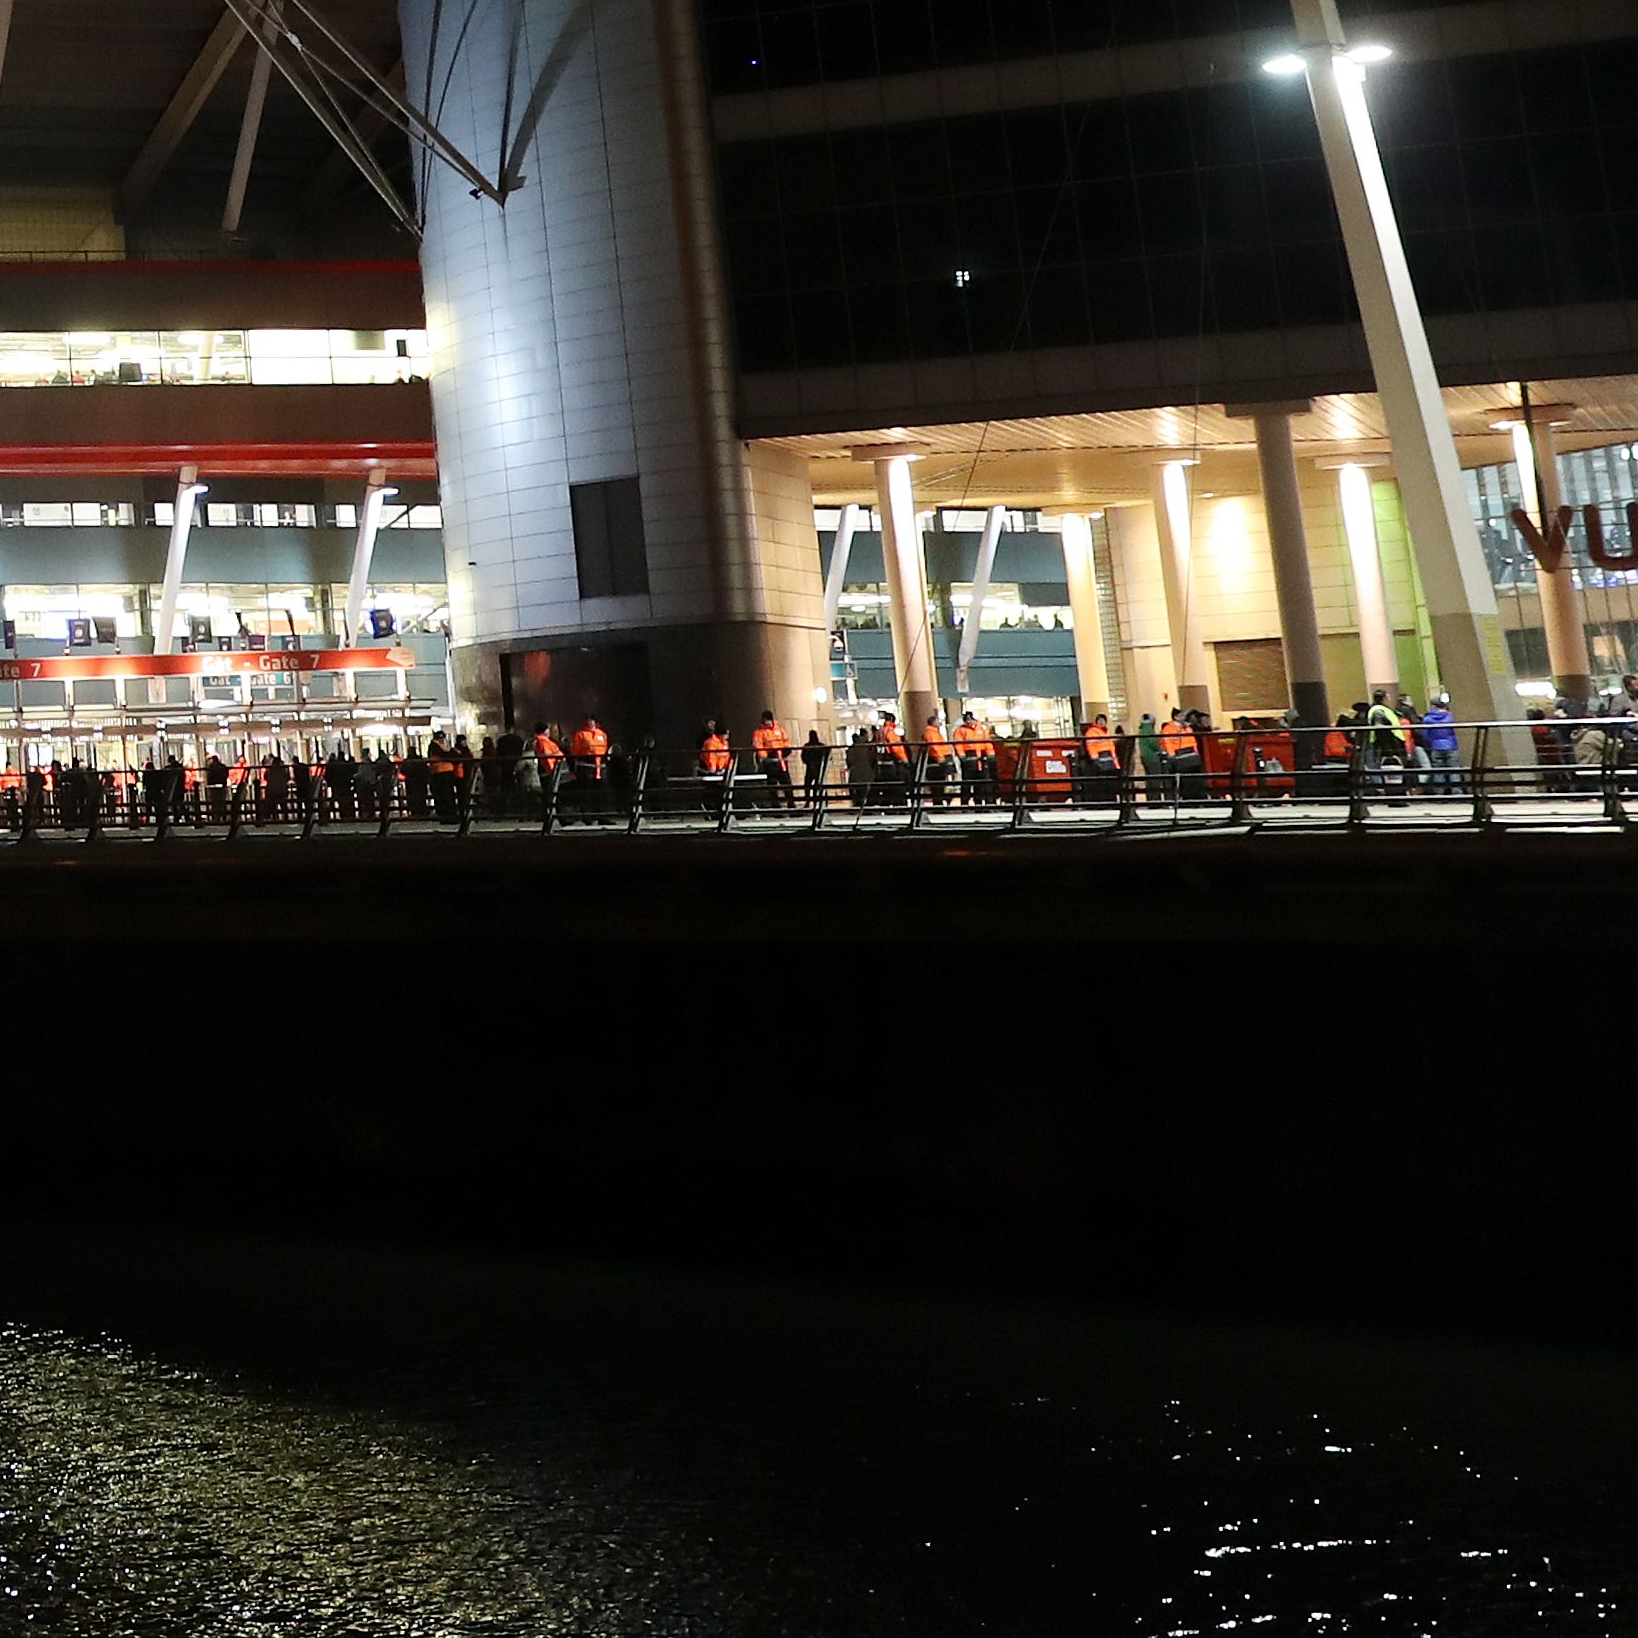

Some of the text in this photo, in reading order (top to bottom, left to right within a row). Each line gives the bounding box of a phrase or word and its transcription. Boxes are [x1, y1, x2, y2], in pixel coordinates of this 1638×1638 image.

[29, 662, 42, 677] 7
[258, 655, 299, 671] Gate
[310, 654, 320, 669] 7
